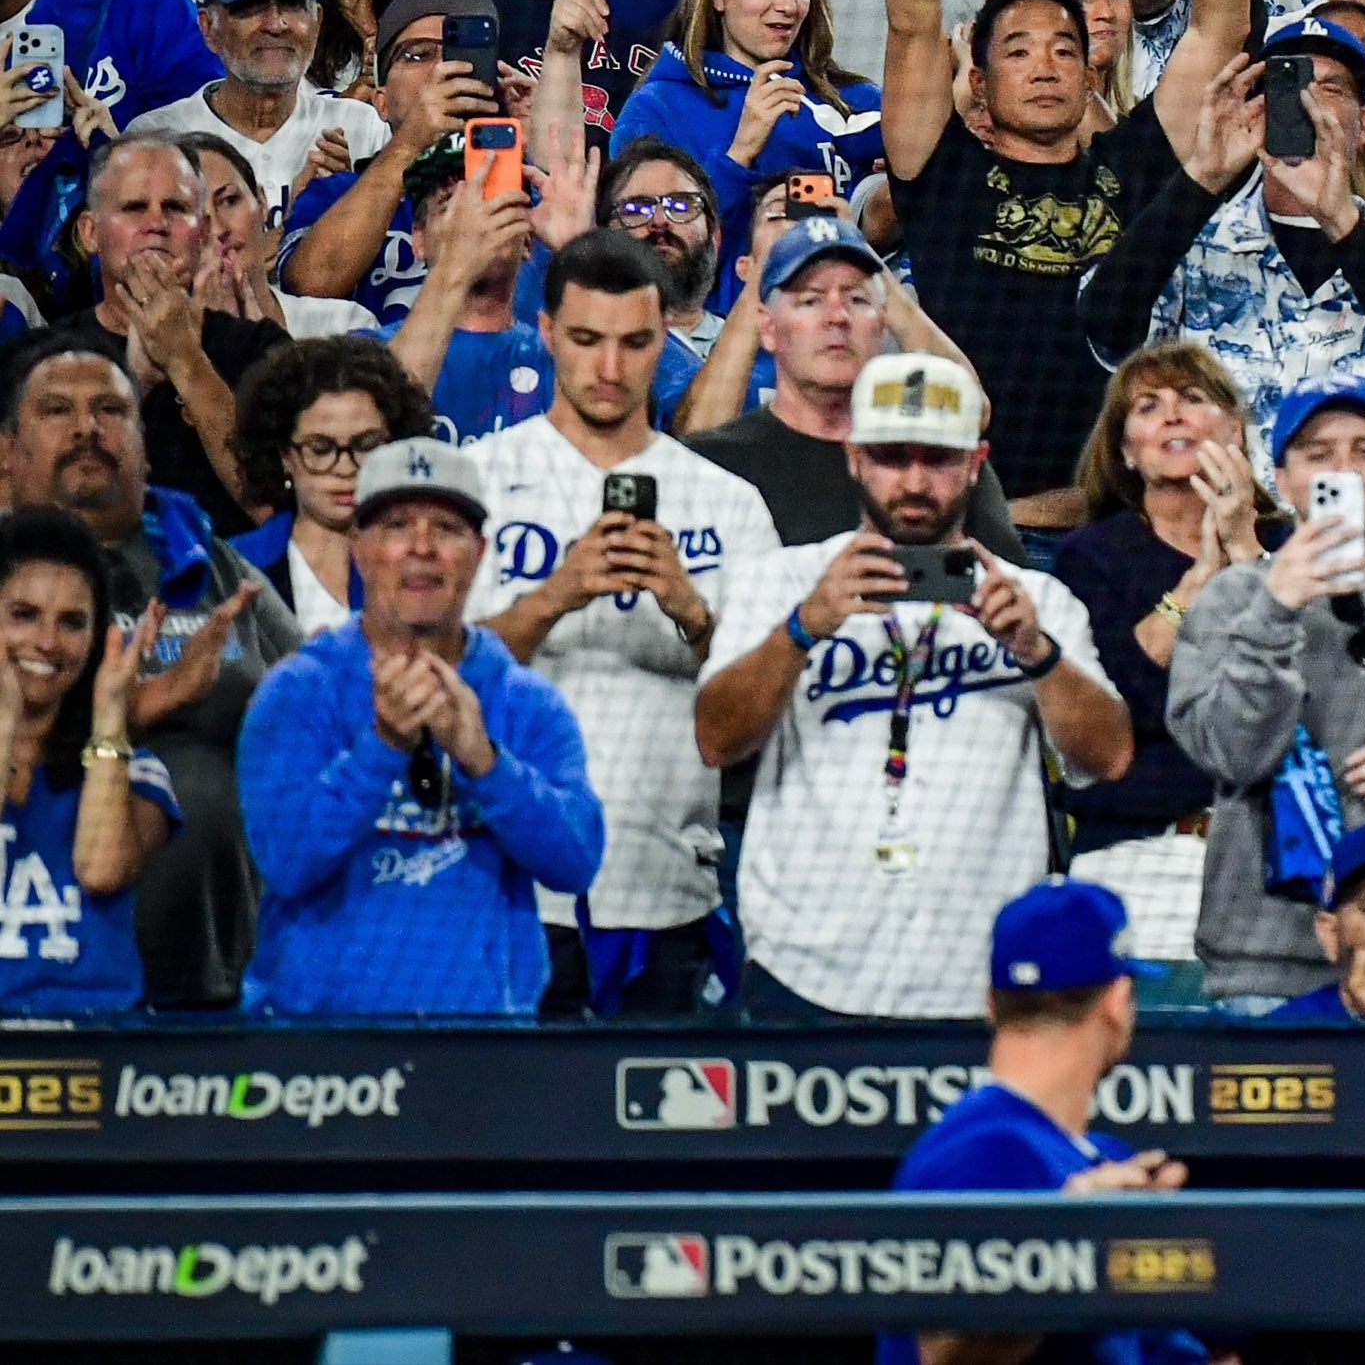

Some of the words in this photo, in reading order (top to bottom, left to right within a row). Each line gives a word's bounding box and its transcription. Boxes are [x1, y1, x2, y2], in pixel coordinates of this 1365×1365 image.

[0, 832, 81, 960] A
[114, 1066, 404, 1128] loanDepot
[746, 1061, 1196, 1127] POSTSON
[1210, 1075, 1336, 1113] 2025
[50, 1238, 368, 1305] loanDepot
[716, 1238, 1097, 1294] POSTSEASON
